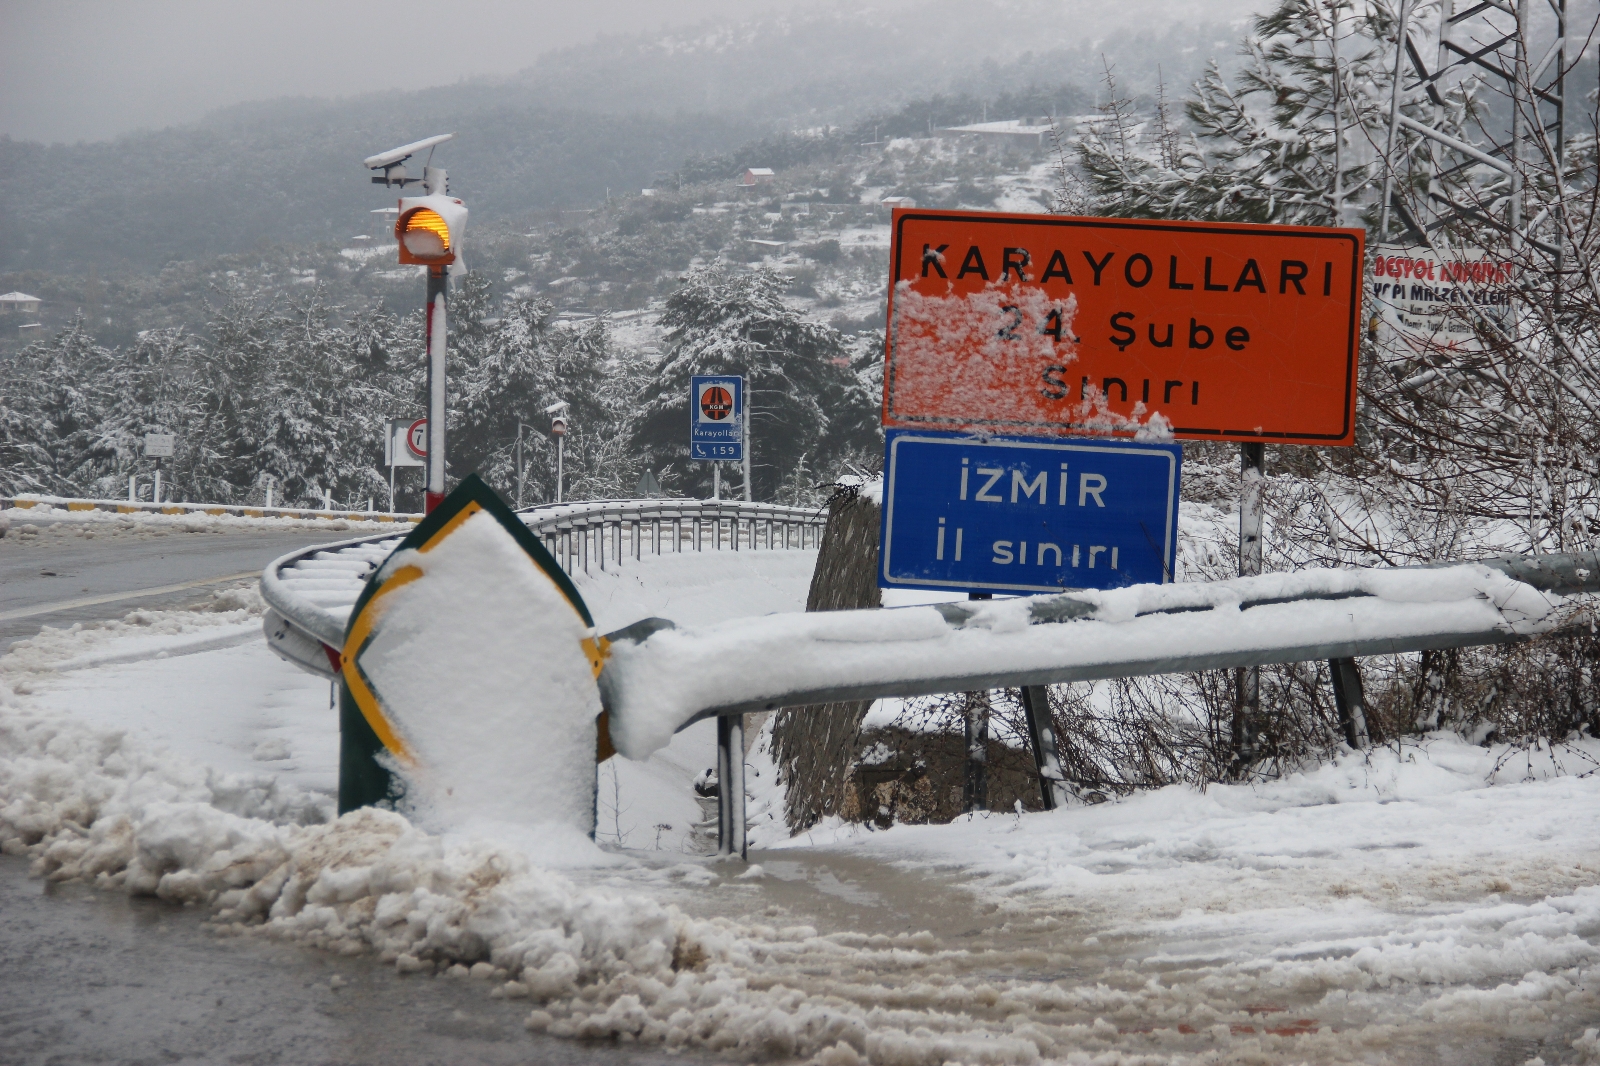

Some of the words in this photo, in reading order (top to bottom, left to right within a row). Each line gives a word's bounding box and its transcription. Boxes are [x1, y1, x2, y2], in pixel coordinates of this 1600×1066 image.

[920, 242, 1333, 297] KARAYOLLARI
[1374, 254, 1435, 283] BEŞYOL
[1108, 310, 1251, 352] Şube
[1040, 364, 1200, 406] Sınırı
[713, 446, 735, 455] 159
[959, 457, 1108, 508] İZMİR
[936, 517, 963, 562] İl
[992, 540, 1119, 570] sınırı
